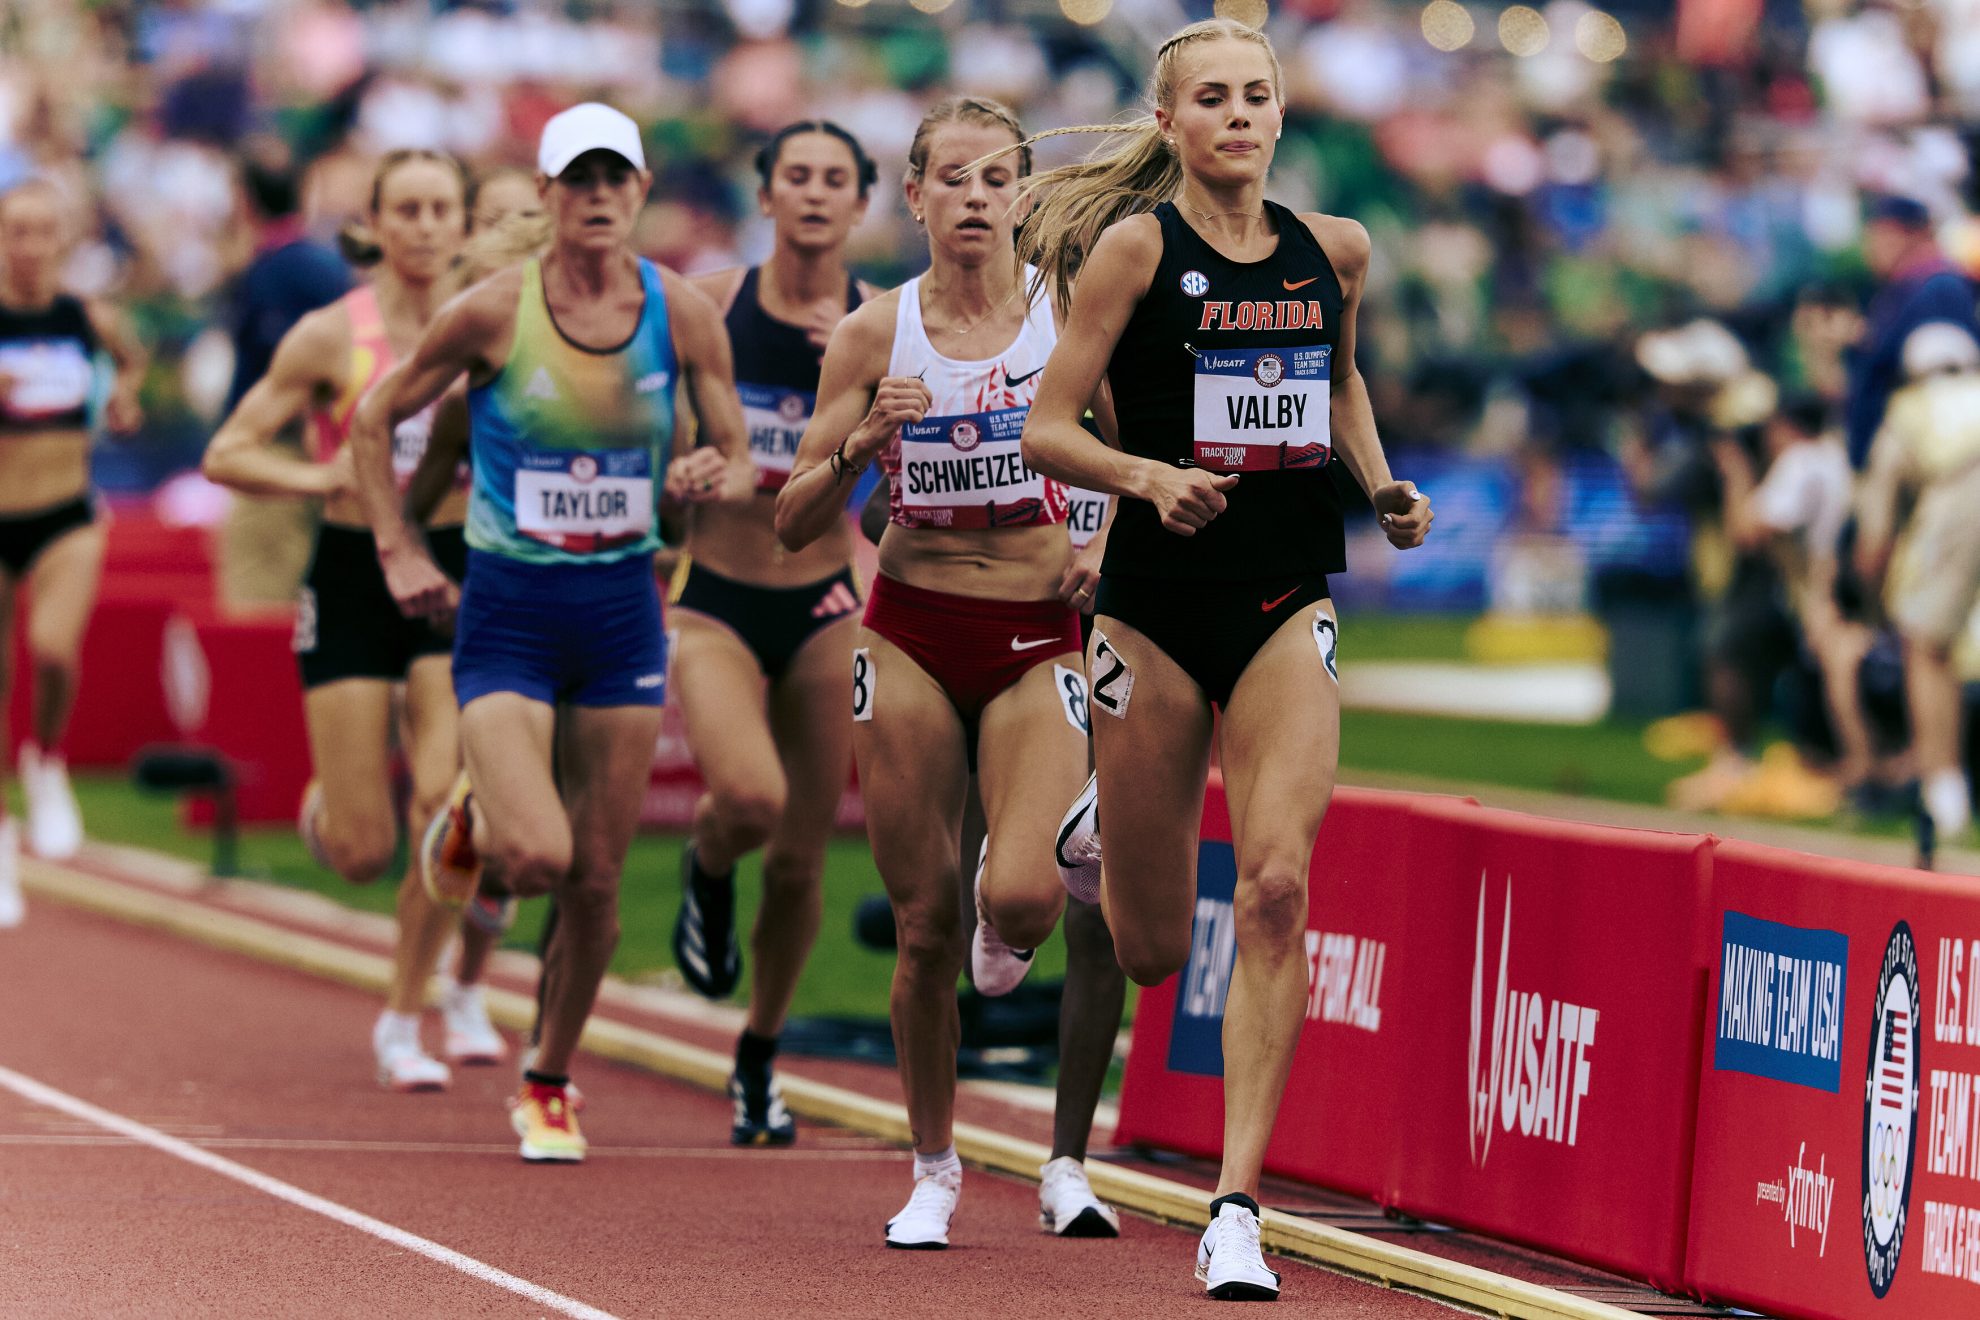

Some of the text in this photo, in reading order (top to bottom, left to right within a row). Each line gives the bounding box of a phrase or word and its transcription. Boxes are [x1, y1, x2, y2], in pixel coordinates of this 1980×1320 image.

[1182, 271, 1207, 295] SEC
[1197, 300, 1323, 330] FLORIDA
[1216, 359, 1246, 368] USATF
[1294, 359, 1325, 370] TEAM TRIALS
[1226, 393, 1308, 430] VALBY
[915, 426, 941, 436] USATF
[1200, 447, 1246, 458] TRACKTOWN
[1224, 456, 1244, 466] 2024
[540, 489, 627, 519] TAYLOR
[854, 653, 868, 716] 8
[1093, 640, 1125, 710] 2
[1063, 673, 1088, 732] 8
[1720, 942, 1842, 1062] MAKING TEAM USA
[1935, 936, 1964, 1045] U.S.
[1501, 989, 1598, 1147] USATF
[1927, 1069, 1972, 1178] TEAM
[1784, 1141, 1834, 1258] xfinity
